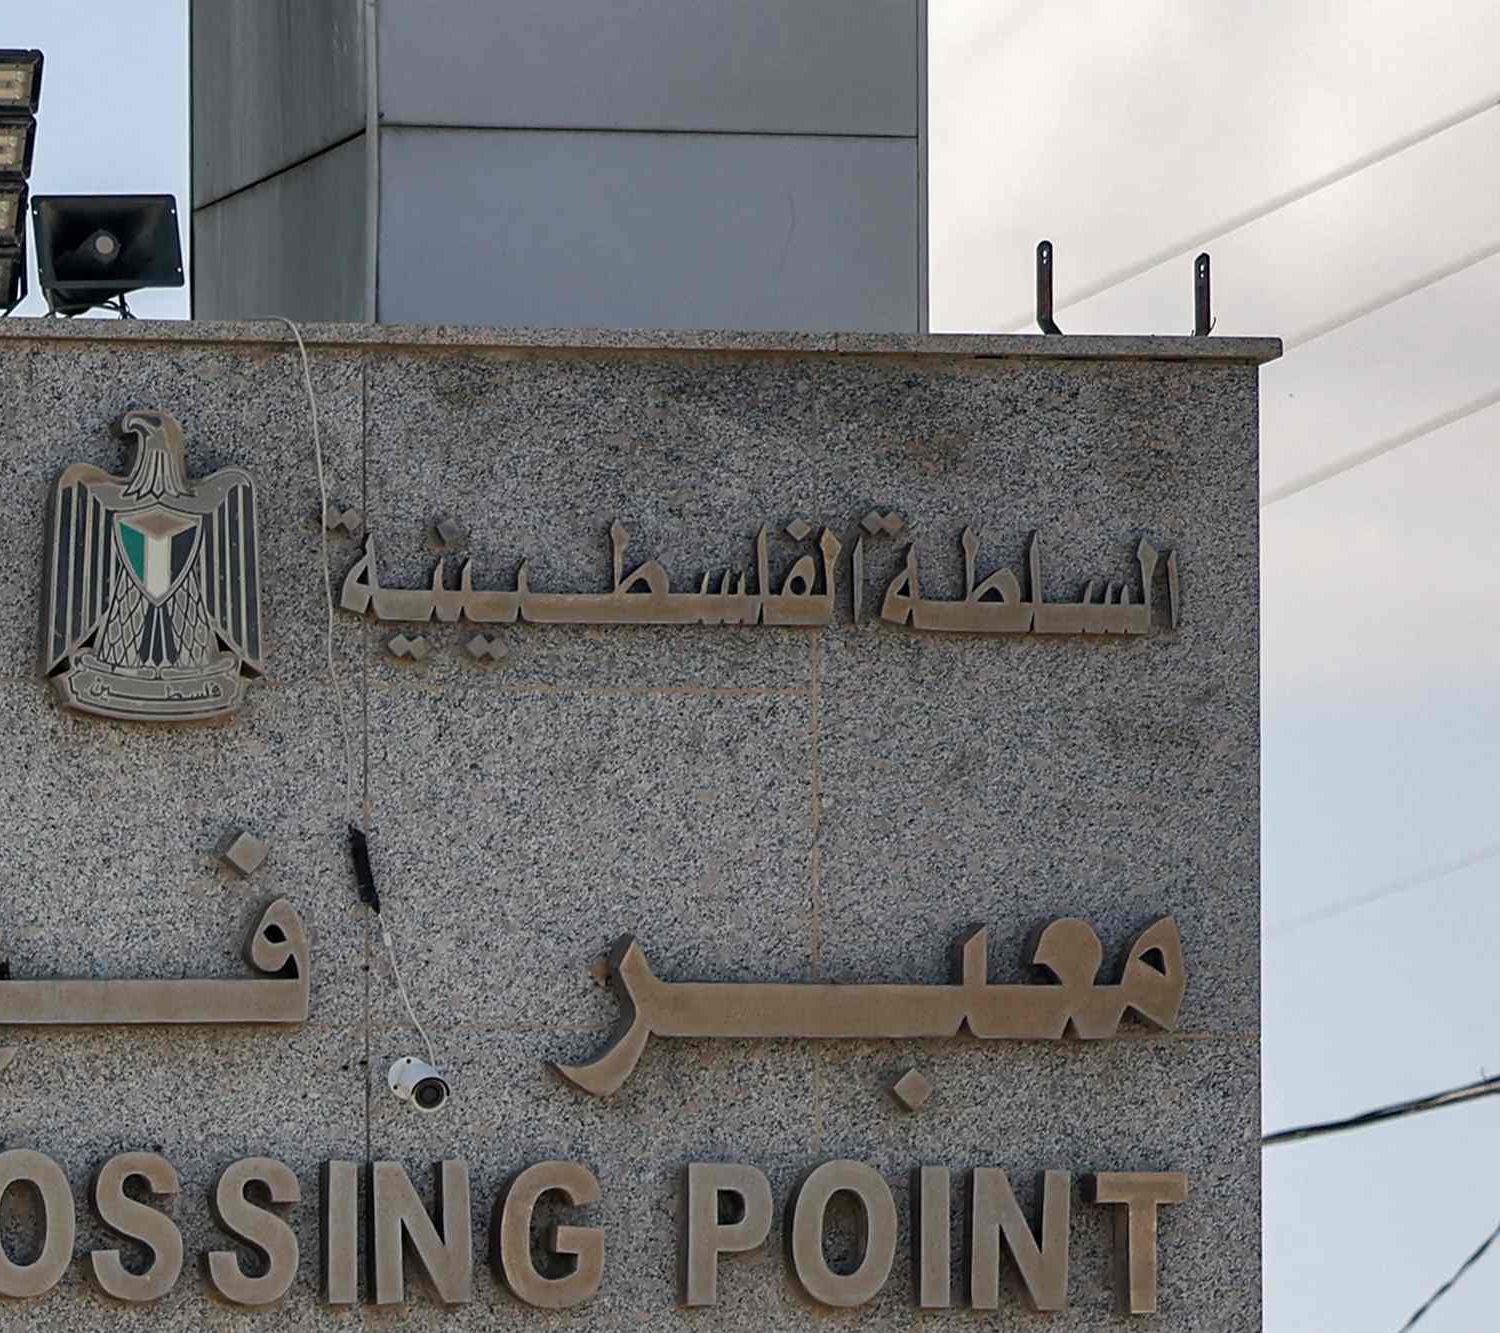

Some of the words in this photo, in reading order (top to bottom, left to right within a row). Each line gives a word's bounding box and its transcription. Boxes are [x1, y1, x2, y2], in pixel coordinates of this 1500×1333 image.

[322, 506, 863, 662] الفلسطينية
[881, 508, 1179, 635] السلطة
[87, 677, 224, 702] فلسطين
[550, 912, 1187, 1112] معبر
[680, 1158, 1189, 1315] POINT
